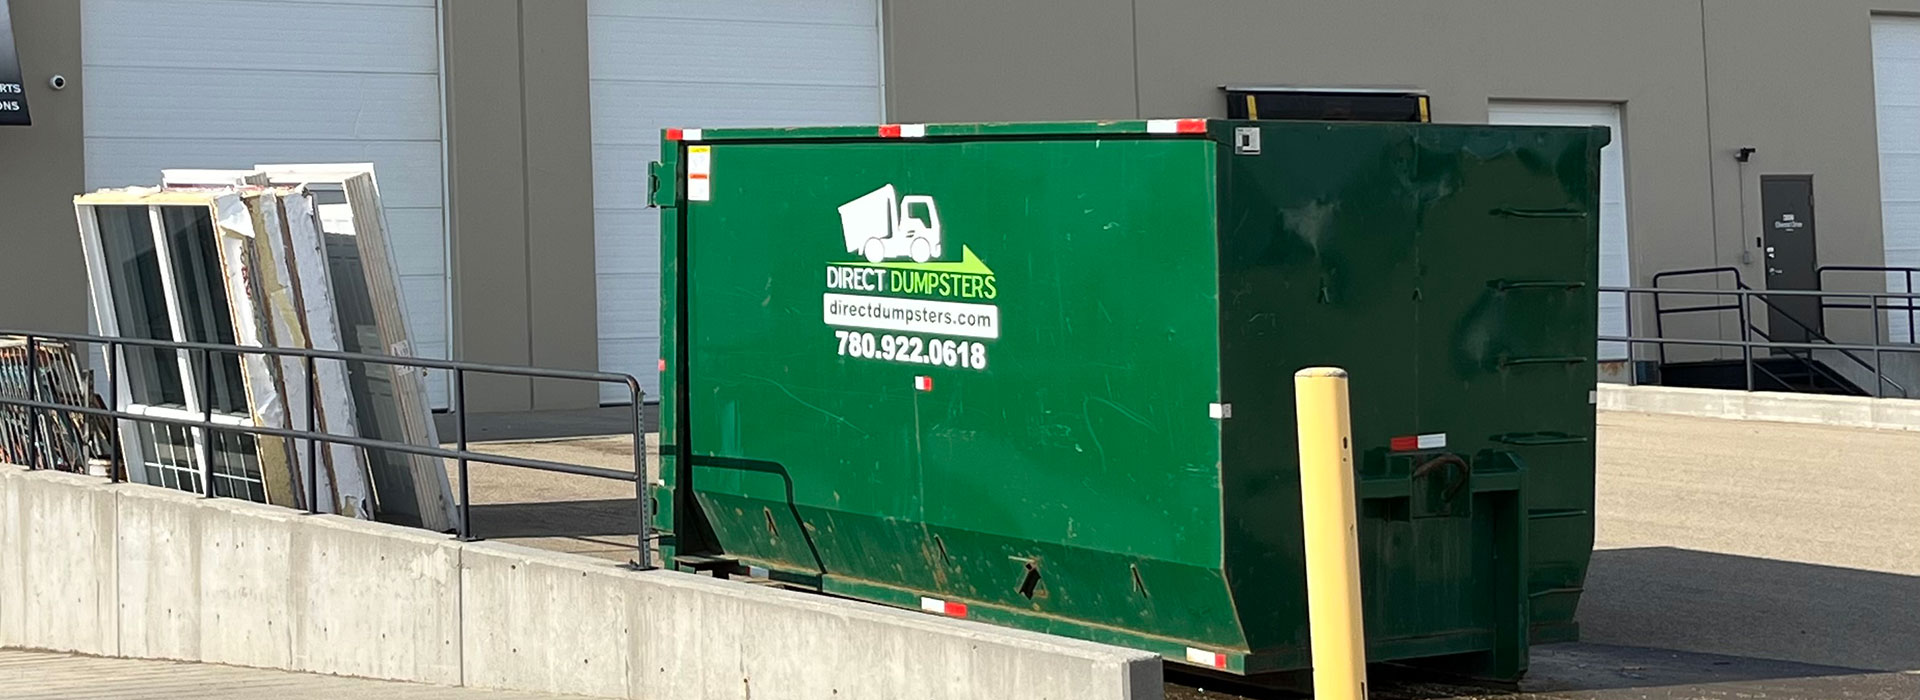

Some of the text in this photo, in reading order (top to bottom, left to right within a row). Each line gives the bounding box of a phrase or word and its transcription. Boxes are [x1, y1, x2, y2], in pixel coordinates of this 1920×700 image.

[826, 266, 997, 299] DIRECT DUMPSTERS
[829, 300, 991, 327] directdumpsters.com
[835, 330, 986, 369] 780.922.0618
